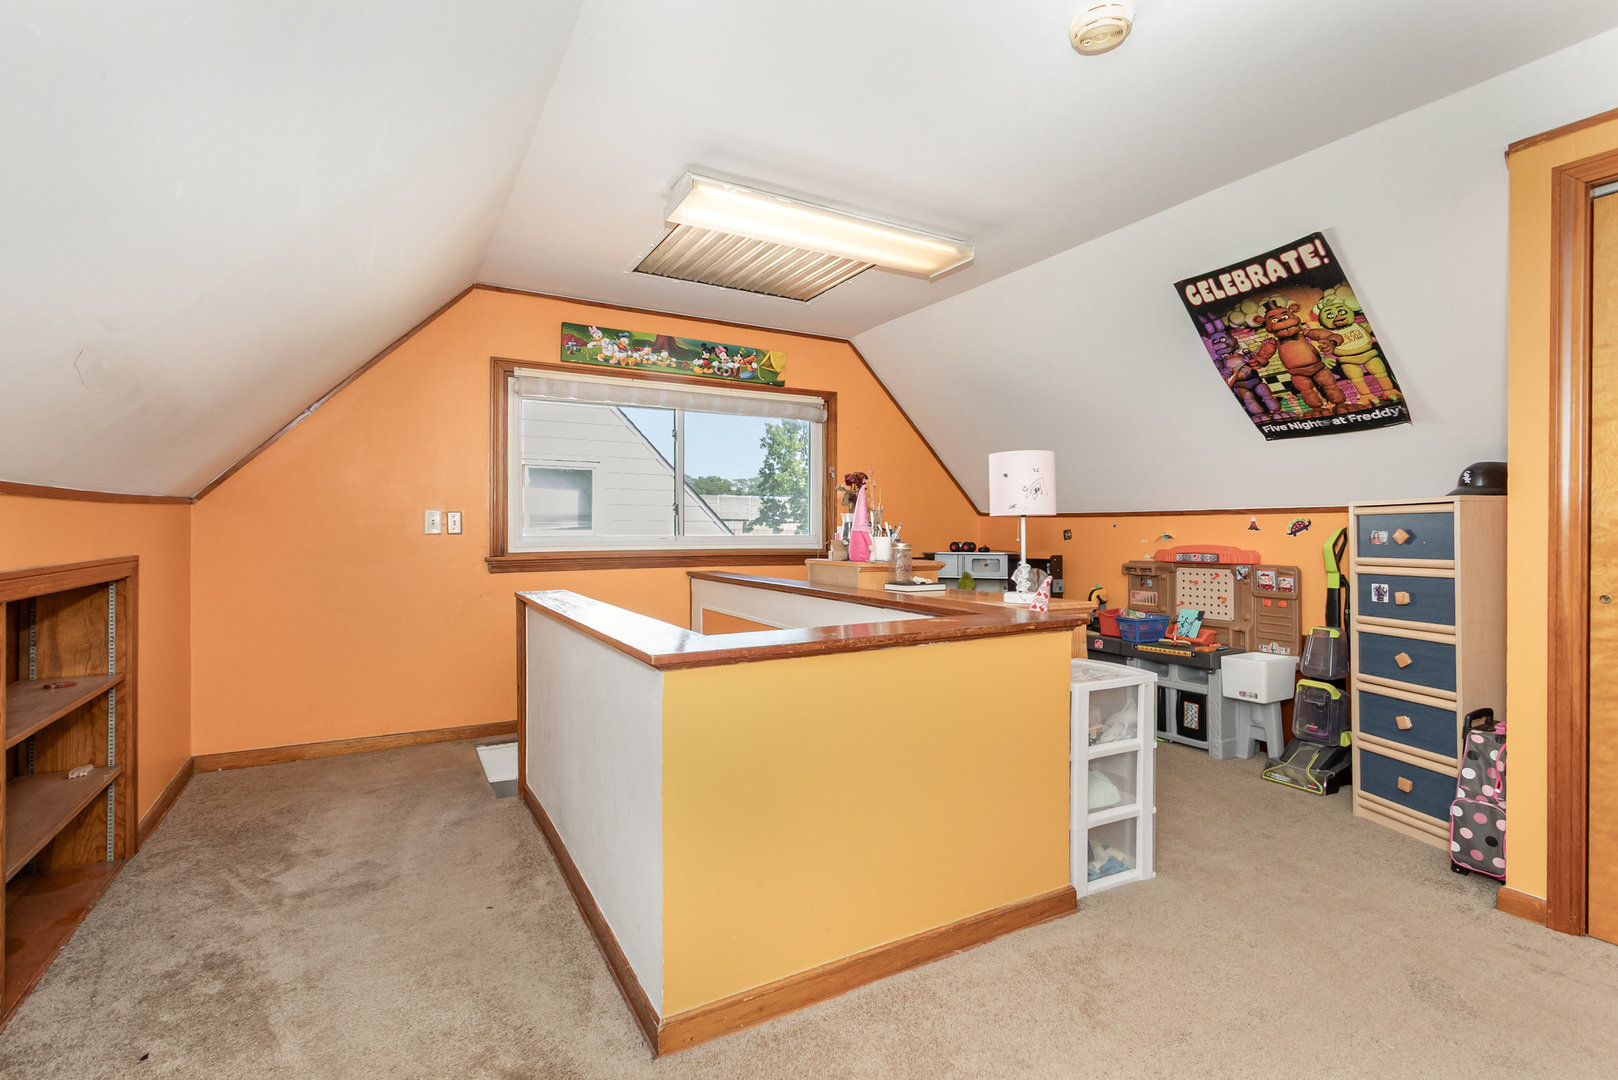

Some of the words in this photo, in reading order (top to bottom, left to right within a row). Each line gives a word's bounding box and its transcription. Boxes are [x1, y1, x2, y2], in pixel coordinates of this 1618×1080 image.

[1185, 239, 1330, 306] CELEBRATE!
[1262, 424, 1288, 433] Five
[1332, 416, 1347, 425] at
